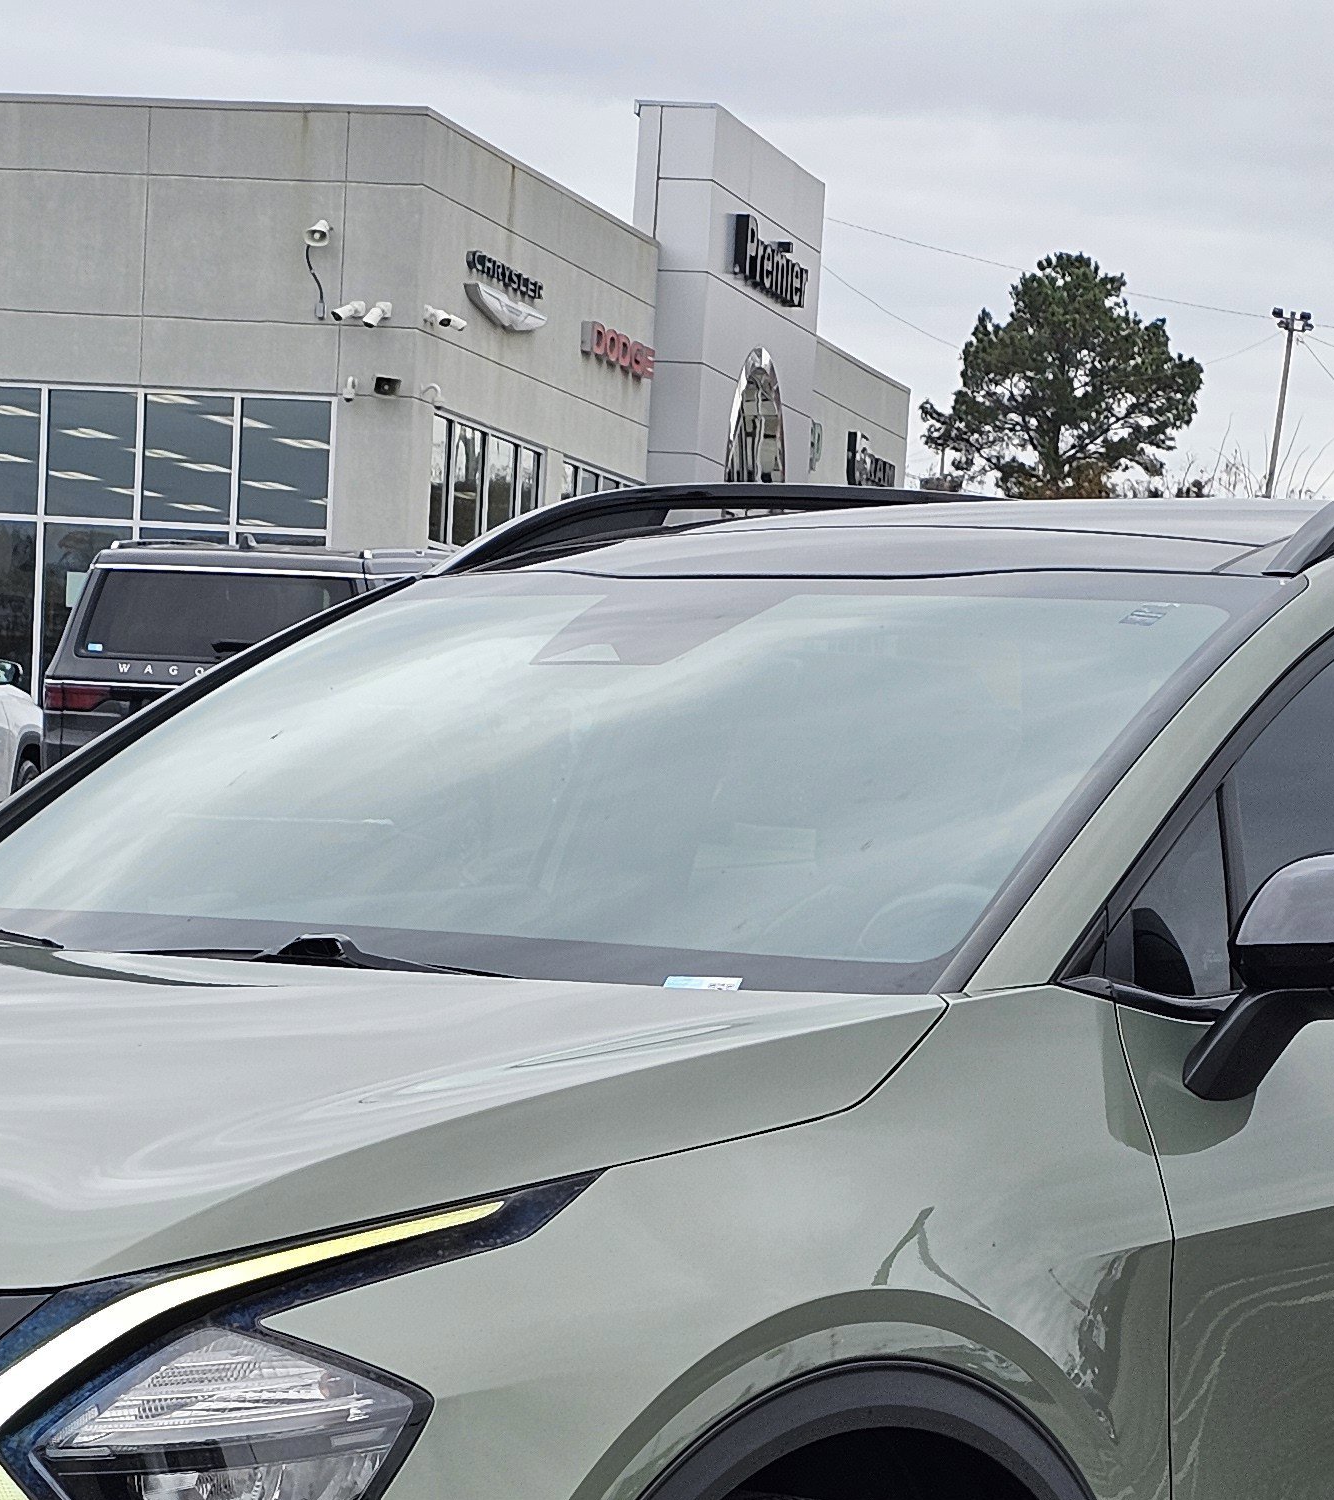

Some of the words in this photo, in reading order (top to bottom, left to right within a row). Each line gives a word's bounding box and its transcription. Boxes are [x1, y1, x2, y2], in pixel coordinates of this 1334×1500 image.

[468, 251, 544, 300] CHRYSLER
[735, 213, 808, 308] Premier
[583, 320, 655, 378] DODGE
